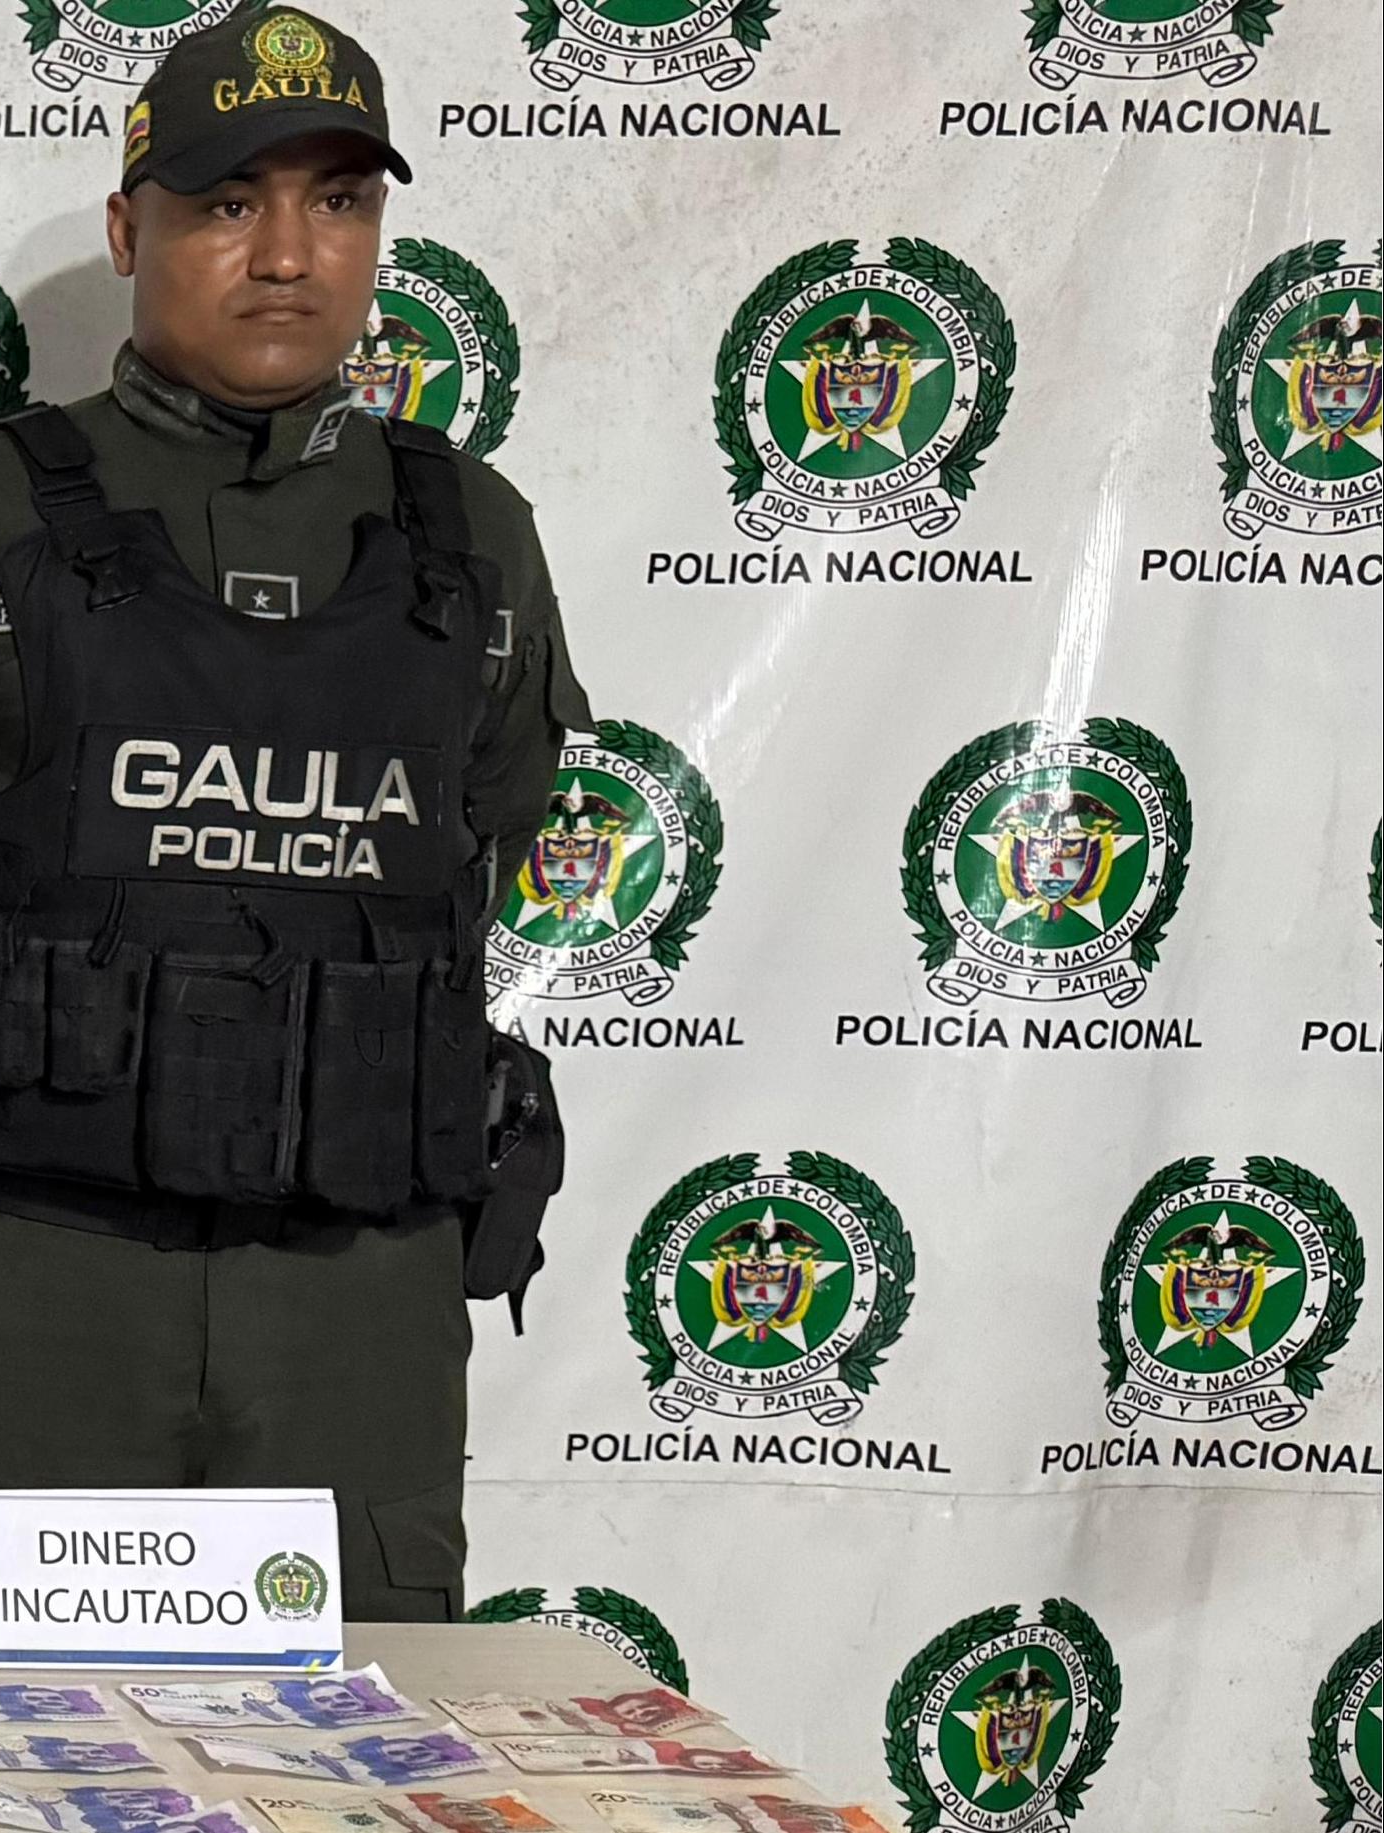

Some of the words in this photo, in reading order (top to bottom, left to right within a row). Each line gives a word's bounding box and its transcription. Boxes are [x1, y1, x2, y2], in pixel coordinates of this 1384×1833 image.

[213, 75, 369, 113] GAULA
[440, 95, 606, 137] POLICÍA
[621, 103, 840, 137] NACIONAL
[940, 94, 1108, 136] POLICÍA
[1123, 98, 1330, 135] NACIONAL
[749, 278, 840, 378] REPUBLICA
[853, 268, 883, 286] DE
[900, 277, 976, 372] COLOMBIA
[757, 439, 825, 497] POLICIA
[853, 434, 957, 498] NACIONAL
[760, 493, 810, 523] DIOS
[826, 510, 841, 527] Y
[857, 491, 938, 525] PATRIA
[648, 545, 810, 584] POLICÍA
[826, 550, 1032, 582] NACIONAL
[1141, 544, 1286, 583] POLICÍA
[109, 738, 420, 826] GAULA
[147, 823, 385, 881] POLICÍA
[544, 1017, 744, 1048] NACIONAL
[836, 1010, 1008, 1048] POLICÍA
[1023, 1018, 1202, 1049] NACIONAL
[659, 1187, 744, 1277] REPUBLICA
[756, 1178, 785, 1194] DE
[802, 1186, 875, 1276] COLOMBIA
[670, 1331, 734, 1383] POLICIA
[759, 1331, 856, 1387] NACIONAL
[672, 1379, 719, 1407] DIOS
[734, 1396, 748, 1412] Y
[762, 1383, 837, 1411] PATRIA
[566, 1426, 719, 1462] POLICÍA
[733, 1435, 951, 1473] NACIONAL
[1042, 1430, 1159, 1473] POLICÍA
[1173, 1438, 1382, 1474] NACIONAL
[37, 1530, 197, 1567] DINERO
[0, 1589, 248, 1627] INCAUTADO
[129, 1686, 161, 1698] 50
[261, 1798, 295, 1810] 20
[591, 1792, 627, 1803] 20
